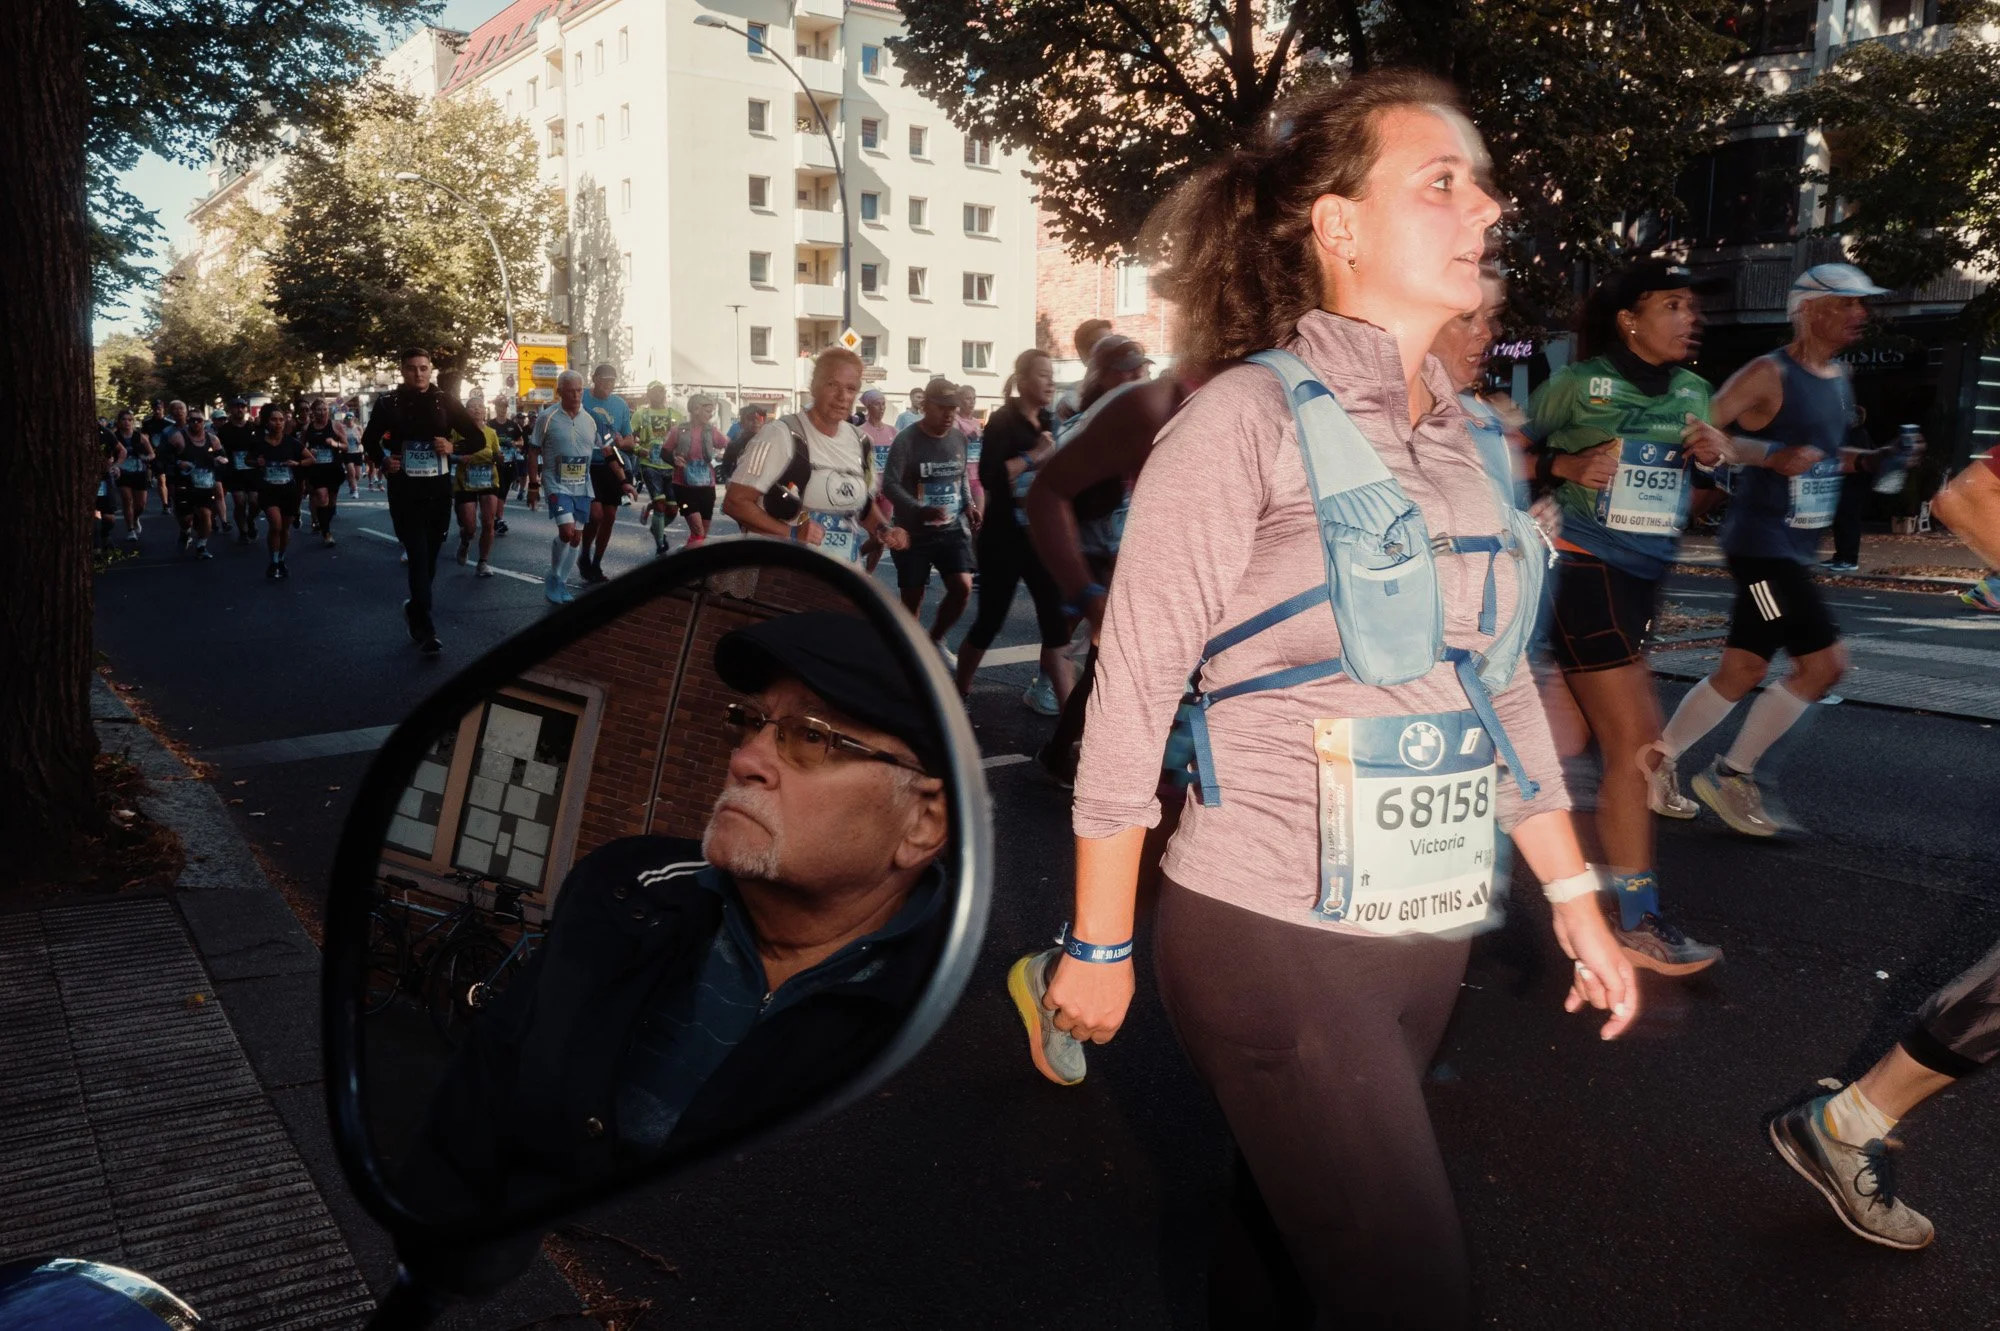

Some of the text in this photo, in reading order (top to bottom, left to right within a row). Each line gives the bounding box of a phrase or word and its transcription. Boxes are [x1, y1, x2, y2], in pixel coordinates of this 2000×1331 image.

[1623, 469, 1677, 490] 19633
[1611, 514, 1661, 527] YOU GOT THIS
[1376, 776, 1489, 831] 68158
[1410, 833, 1466, 856] Victoria
[1355, 889, 1462, 922] YOU GOT THIS
